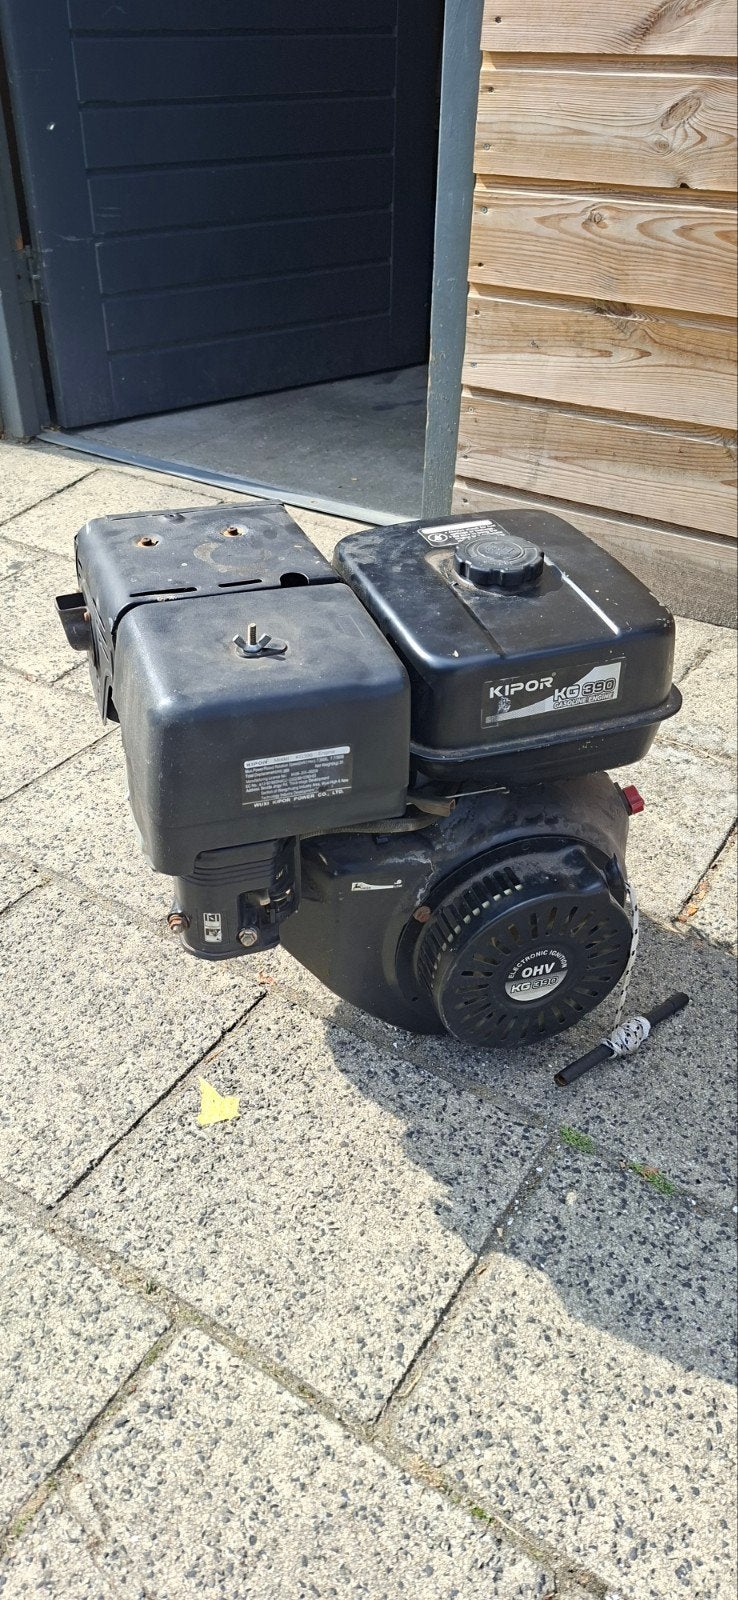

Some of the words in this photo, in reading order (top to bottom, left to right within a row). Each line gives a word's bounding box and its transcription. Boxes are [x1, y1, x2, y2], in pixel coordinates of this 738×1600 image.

[489, 677, 553, 698] KIPOR
[554, 685, 579, 701] KG
[581, 678, 616, 696] 390
[553, 698, 586, 709] GASOLINE
[588, 693, 614, 701] ENGINE
[508, 950, 548, 979] ELECTRONIC
[549, 950, 567, 968] IGNITION
[521, 962, 555, 978] OHV
[510, 982, 531, 993] KG
[532, 976, 559, 989] 390
